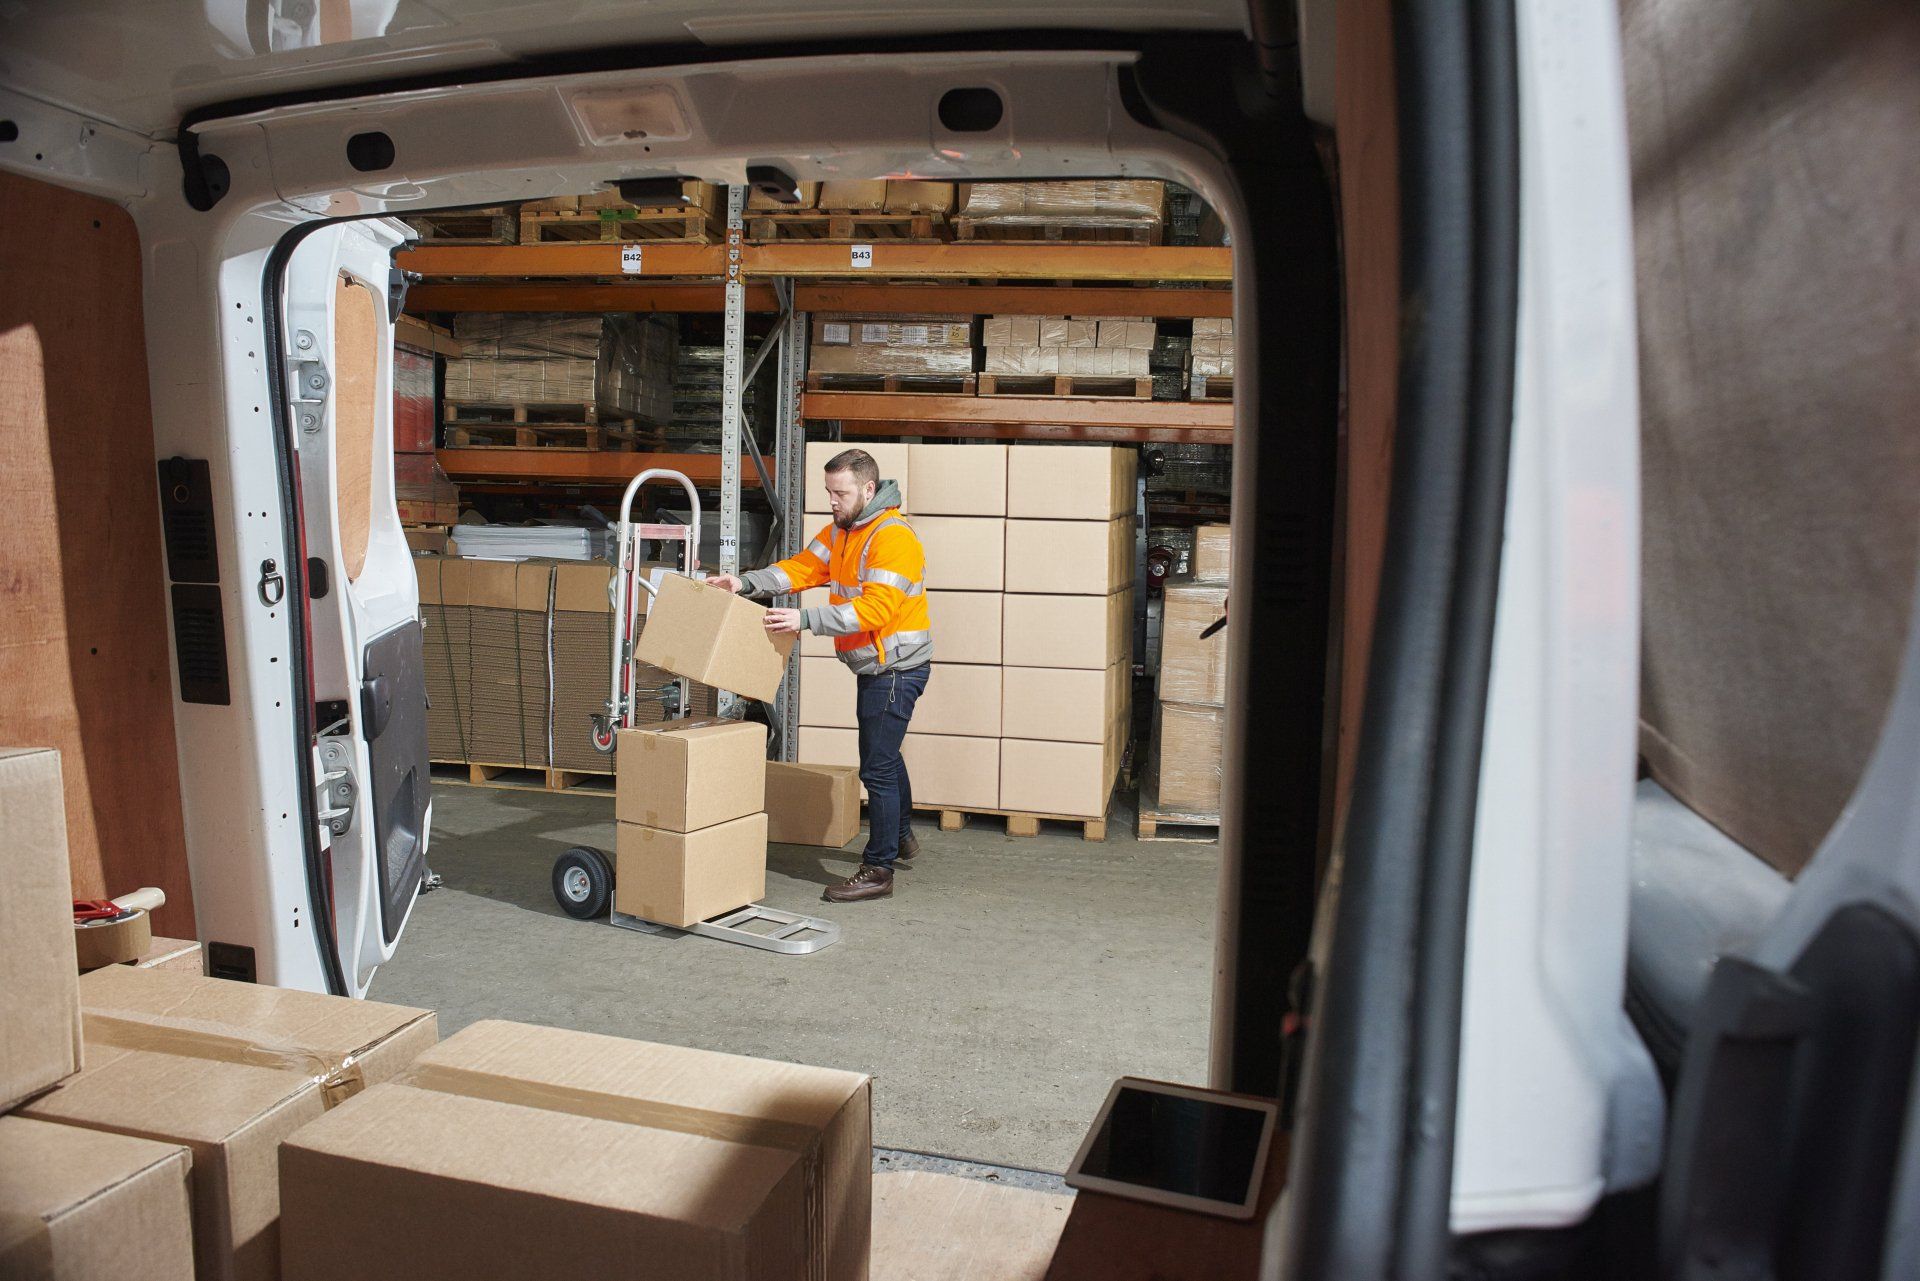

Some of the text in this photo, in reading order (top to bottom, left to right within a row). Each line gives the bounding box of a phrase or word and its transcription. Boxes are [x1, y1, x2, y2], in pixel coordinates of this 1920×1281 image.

[623, 253, 641, 261] B42
[852, 251, 871, 260] B43
[719, 538, 736, 547] B16
